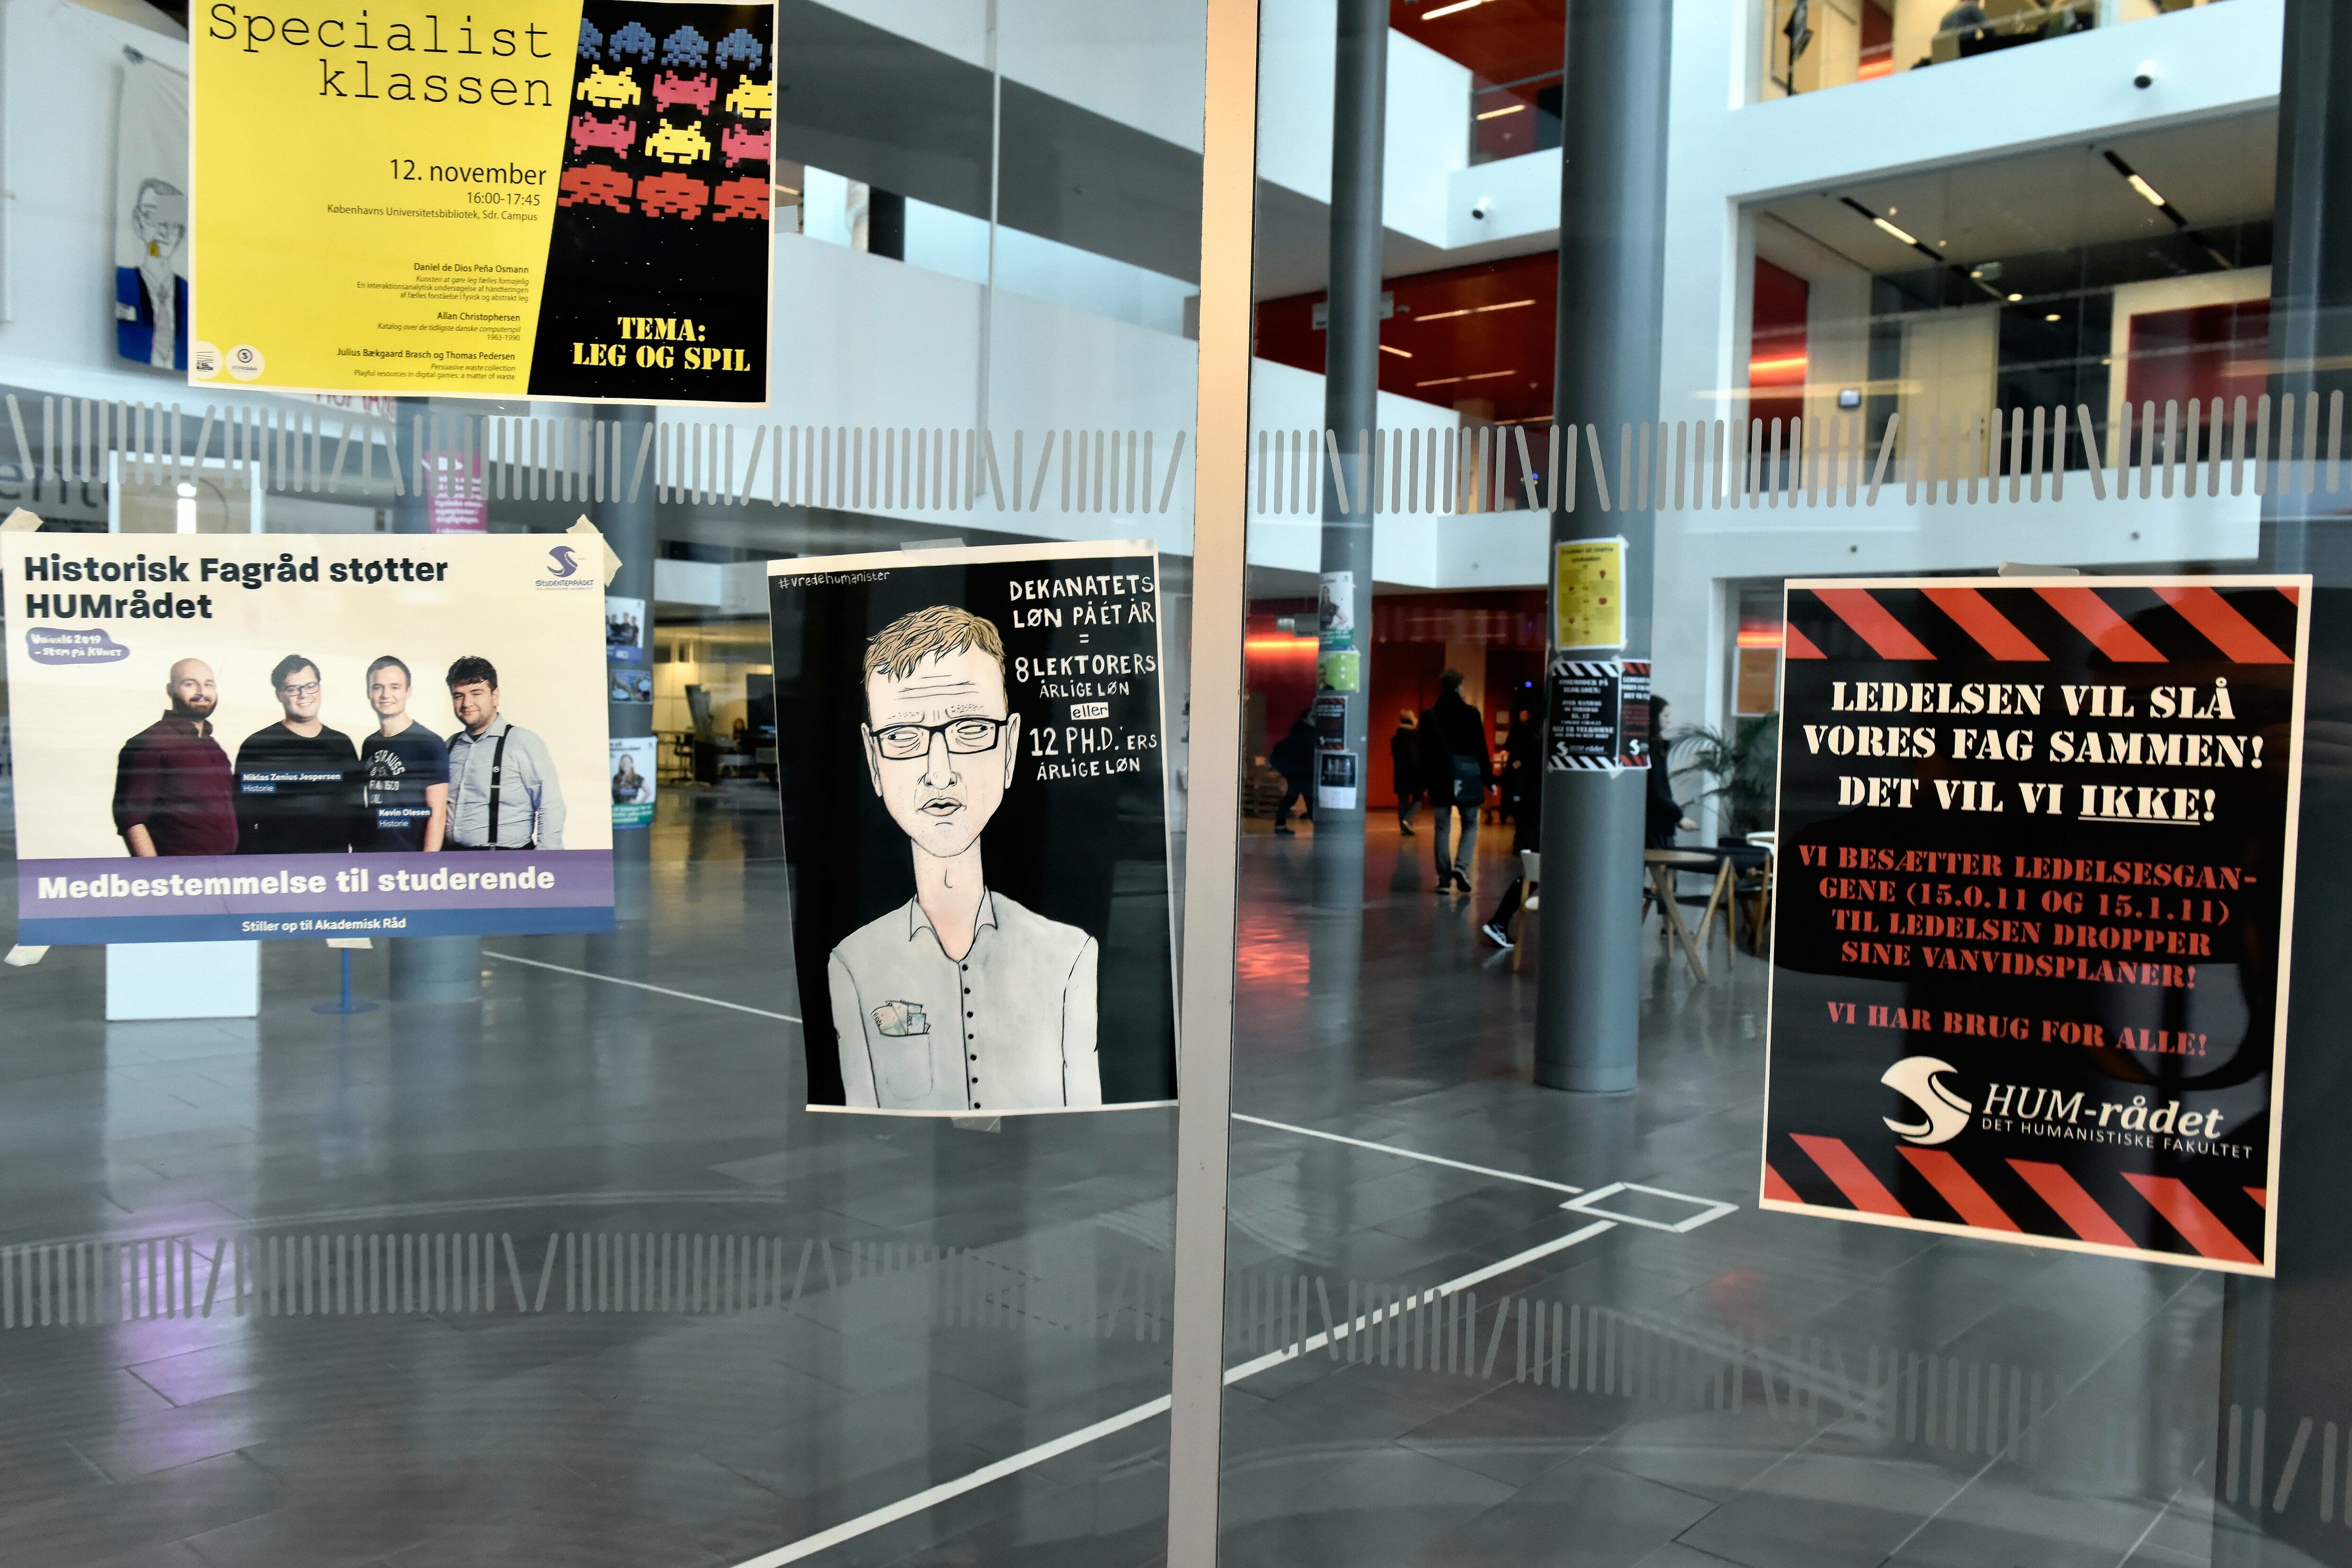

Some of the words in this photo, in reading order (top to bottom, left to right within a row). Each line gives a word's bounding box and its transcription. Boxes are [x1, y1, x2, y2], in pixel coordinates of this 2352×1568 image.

[209, 3, 552, 59] Specialist
[319, 58, 552, 107] klassen
[390, 159, 423, 181] 12.
[430, 162, 547, 185] november
[327, 204, 384, 216] Københavns
[386, 206, 480, 220] Universitetsbibliotek,
[483, 210, 499, 220] Sdr.
[501, 211, 538, 221] Campus
[467, 192, 540, 207] 16:00-17:45
[414, 263, 439, 271] Daniel
[455, 264, 472, 272] Dios
[378, 322, 403, 331] Katalog
[437, 312, 458, 320] Allan
[459, 313, 521, 323] Christophersen
[617, 317, 705, 342] TEMA:
[337, 348, 361, 357] Julius
[363, 349, 403, 359] Bækgaard
[405, 350, 431, 359] Brasch
[434, 352, 444, 360] og
[446, 351, 476, 359] Thomas
[479, 352, 515, 360] Pedersen
[572, 342, 626, 367] LEG
[636, 345, 674, 368] OG
[684, 347, 750, 371] SPIL
[415, 371, 435, 379] digital
[25, 553, 191, 582] Historisk
[200, 553, 319, 590] Fagråd
[330, 558, 448, 584] støtter
[778, 570, 890, 589] #vredehumanister
[1010, 575, 1154, 601] DEKANATETS
[26, 589, 213, 619] HUMrådet
[1013, 608, 1062, 628] LØN
[1128, 598, 1155, 624] ÅR
[1039, 679, 1093, 698] ÅRLIGE
[1098, 681, 1129, 697] LØN
[1831, 681, 2045, 715] LEDELSEN
[2061, 685, 2134, 718] VIL
[2149, 677, 2236, 720] SLÅ
[1072, 705, 1107, 718] eller
[1029, 727, 1058, 756] 12
[1803, 724, 1937, 758] VORES
[1951, 729, 2034, 762] FAG
[2049, 731, 2264, 769] SAMMEN!
[1037, 758, 1100, 781] ÅRLIGE
[1105, 757, 1141, 774] LØN
[1838, 776, 1919, 808] DET
[1936, 780, 2004, 812] VIL
[2018, 783, 2063, 815] VI
[2079, 784, 2217, 822] IKKE!
[1799, 845, 1827, 868] VI
[1838, 846, 2003, 877] BESÆTTER
[2013, 856, 2258, 890] LEDELSESGAN-
[38, 870, 327, 899] Medbestemmelse
[336, 869, 369, 892] til
[378, 866, 555, 892] studerende
[1819, 877, 1896, 903] GENE
[1906, 882, 2028, 911] (15.0.11
[2041, 889, 2084, 914] OG
[2099, 895, 2230, 926] 15.1.11)
[242, 920, 280, 932] Stiller
[282, 922, 297, 933] op
[300, 919, 312, 930] til
[315, 917, 381, 930] Akademisk
[383, 916, 406, 929] Råd
[1831, 909, 1879, 933] TIL
[1889, 913, 2042, 944] LEDELSEN
[2053, 926, 2212, 957] DROPPER
[1841, 941, 1911, 966] SINE
[1921, 947, 2197, 989] VANVIDSPLANER!
[1827, 1001, 1857, 1025] VI
[1868, 1004, 1932, 1032] HAR
[1943, 1011, 2031, 1041] BRUG
[2041, 1020, 2106, 1047] FOR
[2114, 1028, 2208, 1055] ALLE!
[1982, 1082, 2224, 1139] HUM-rådet
[1982, 1118, 2013, 1133] DET
[2022, 1122, 2155, 1148] HUMANISTISKE
[2164, 1137, 2253, 1159] FAKULTET
